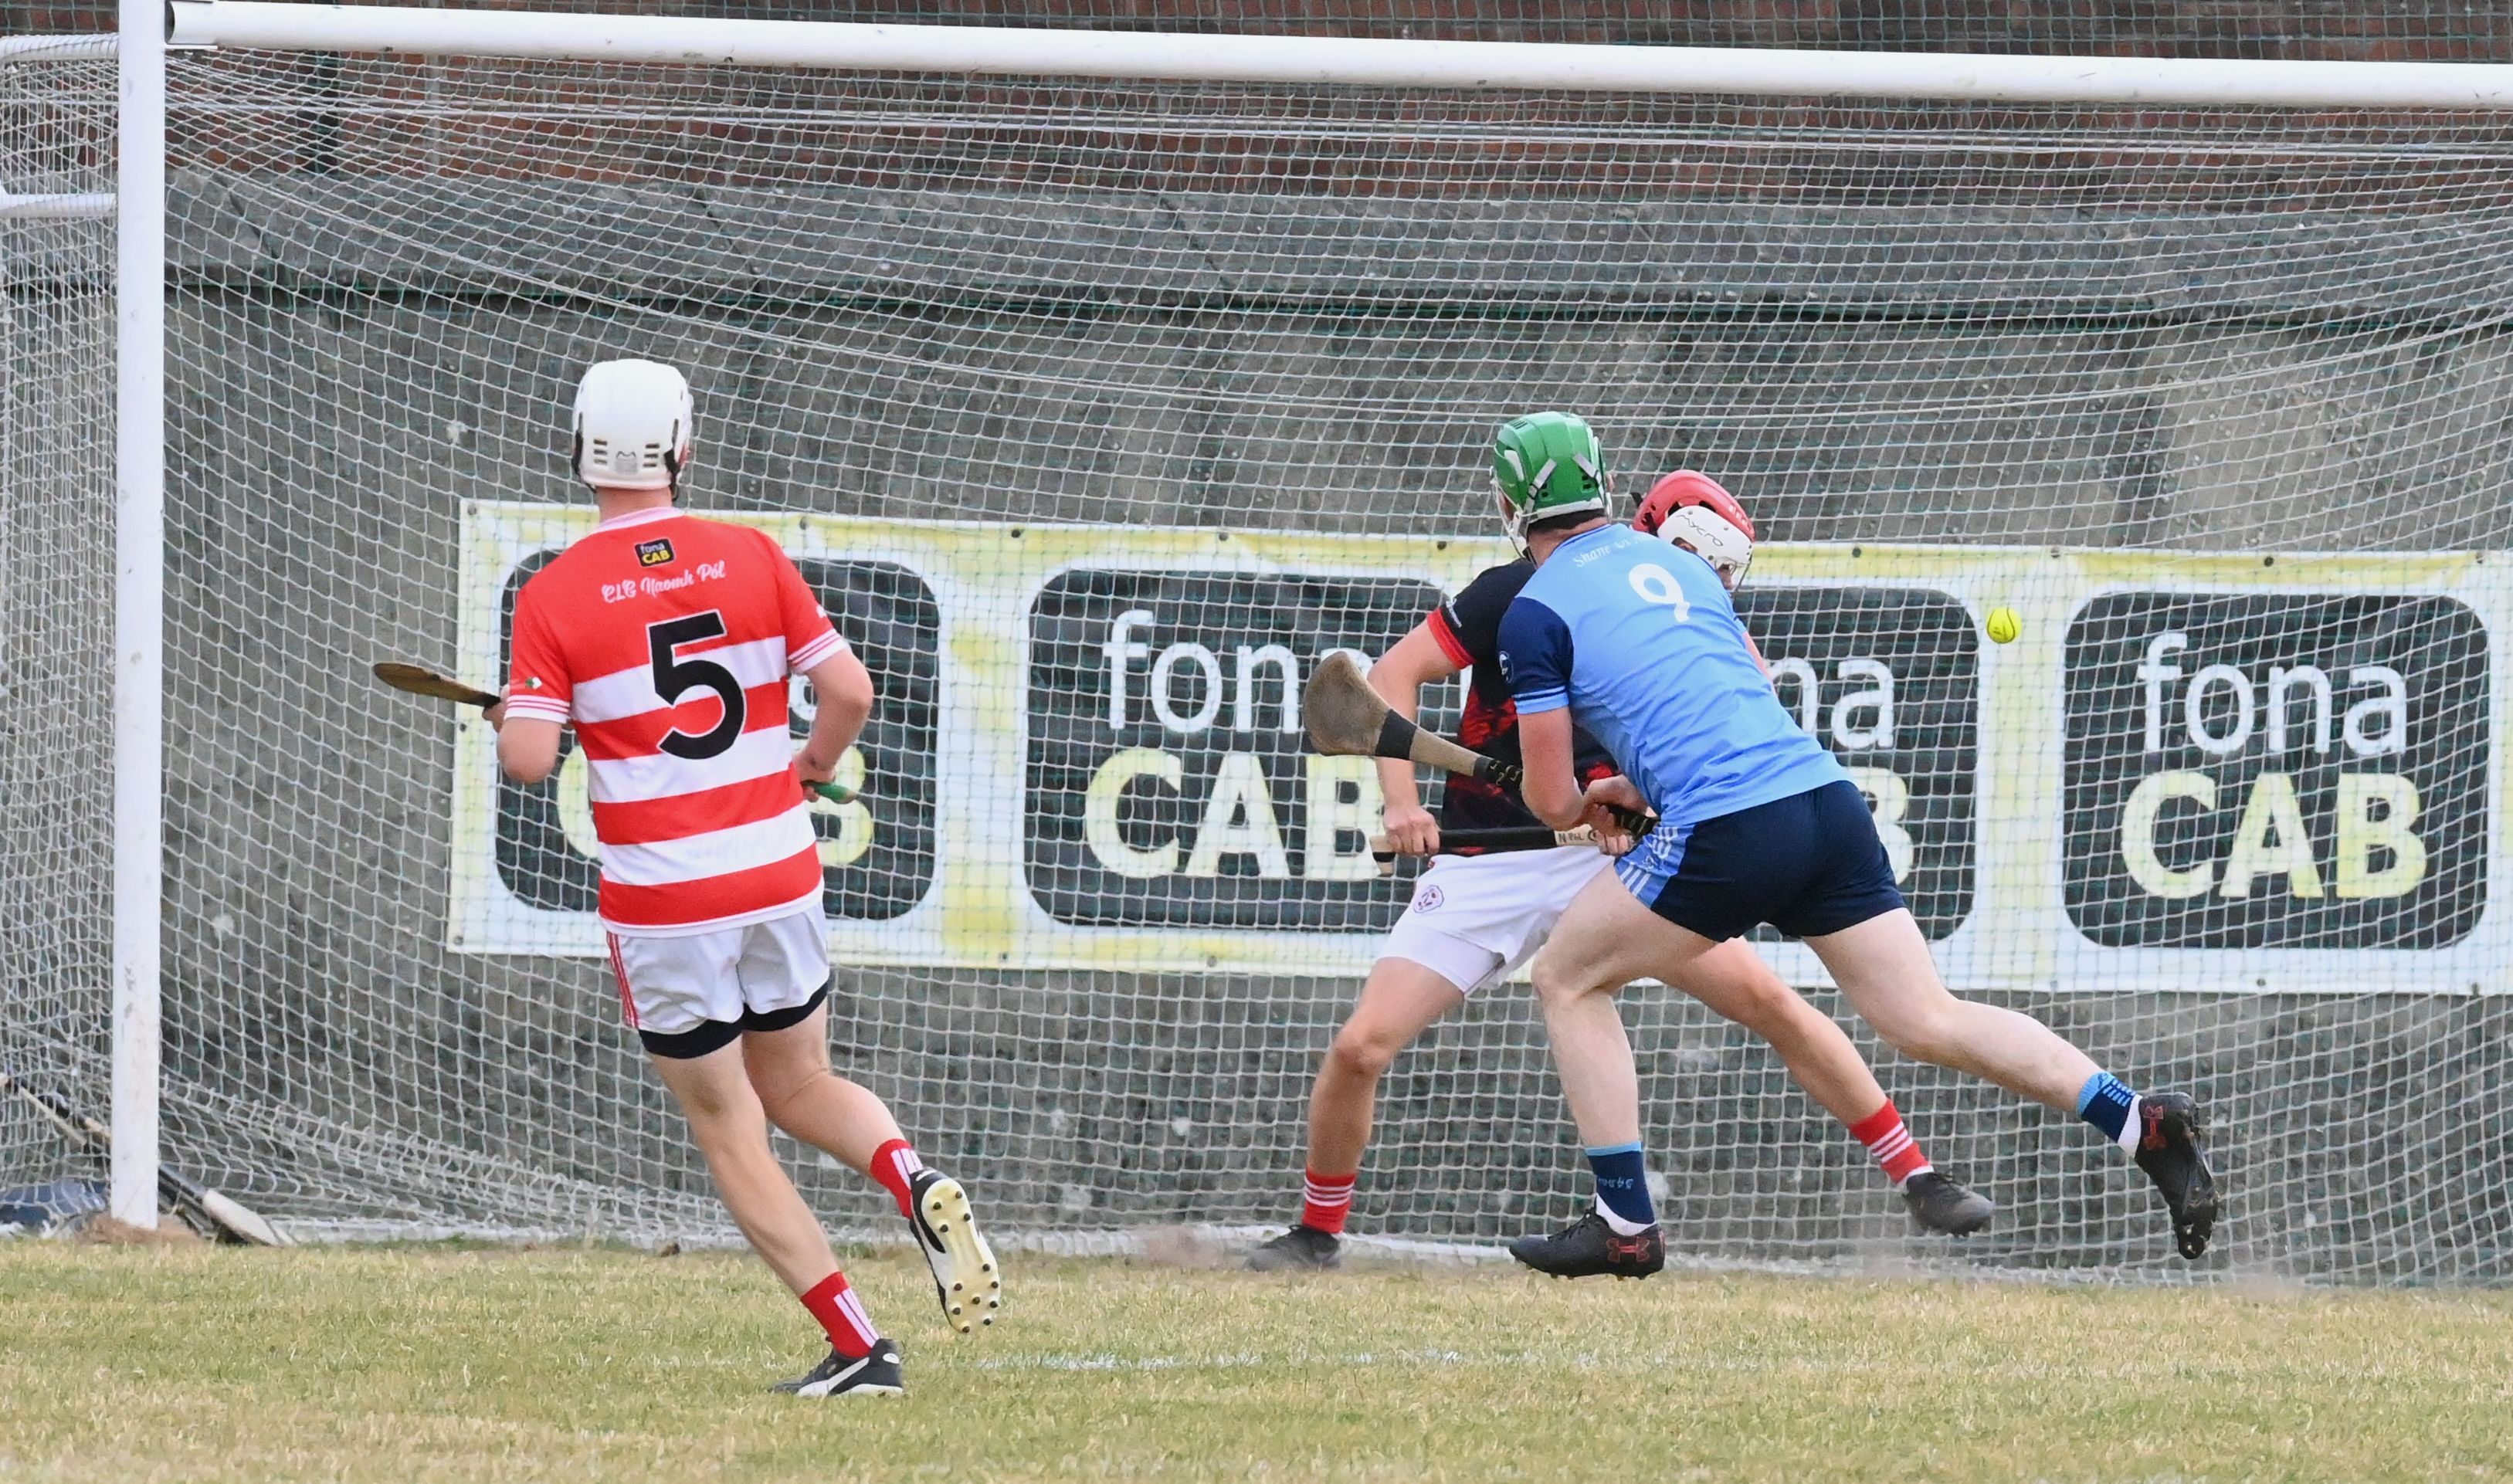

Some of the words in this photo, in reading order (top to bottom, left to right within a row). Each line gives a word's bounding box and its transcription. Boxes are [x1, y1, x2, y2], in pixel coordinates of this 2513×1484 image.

[639, 569, 695, 598] Naomh
[640, 543, 665, 554] fona
[642, 550, 670, 564] CAB
[1628, 563, 1690, 622] 9
[646, 608, 747, 761] 5
[1102, 608, 1375, 734] fon
[2136, 632, 2407, 756] fona
[1084, 747, 1385, 882] CAB
[2121, 769, 2427, 900] CAB
